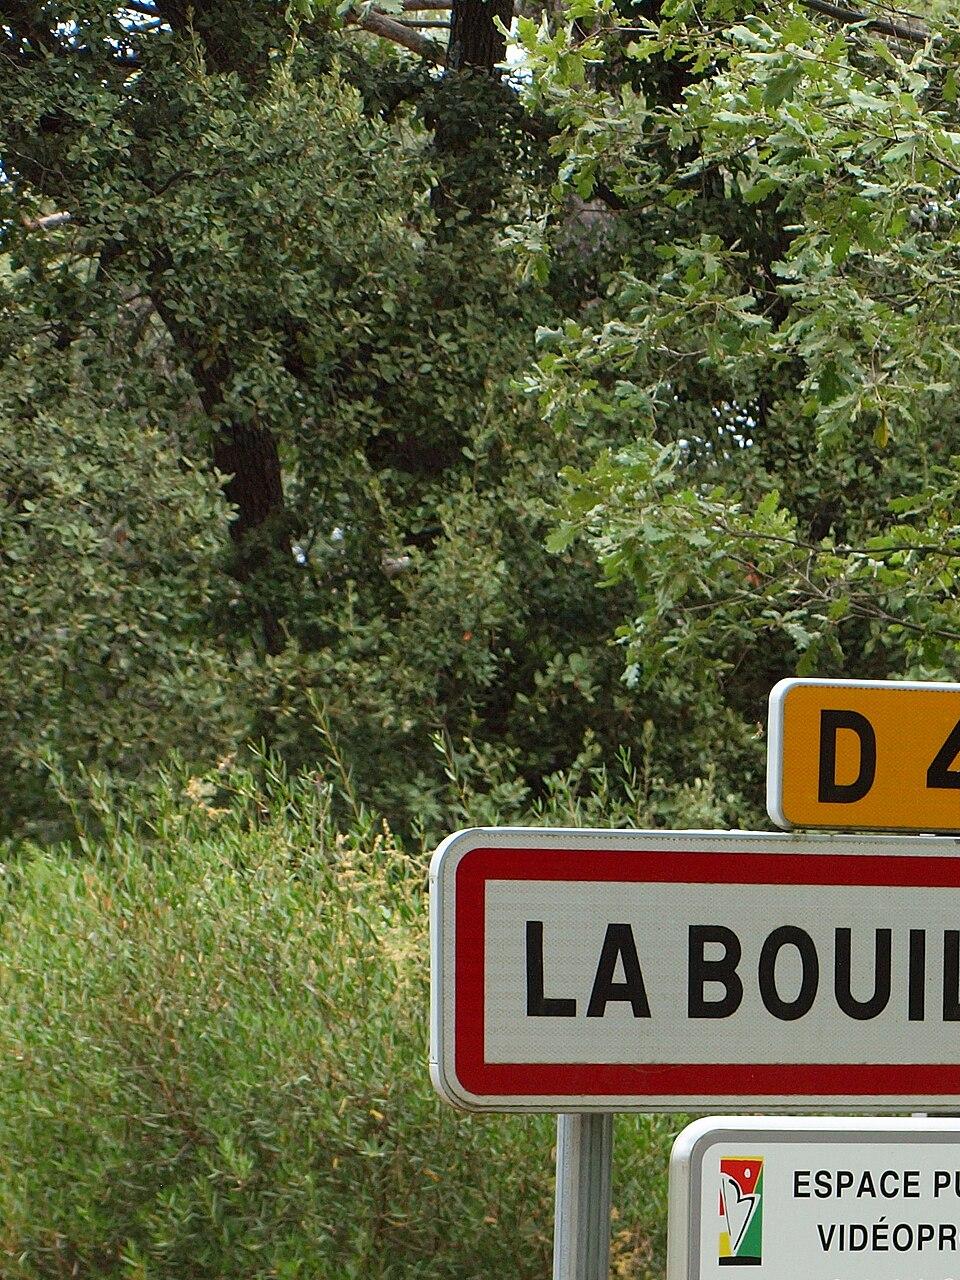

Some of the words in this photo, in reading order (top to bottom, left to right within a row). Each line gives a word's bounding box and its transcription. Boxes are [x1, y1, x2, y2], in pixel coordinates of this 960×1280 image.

[817, 708, 877, 805] D
[525, 920, 652, 1019] LA
[793, 1169, 921, 1199] ESPACE
